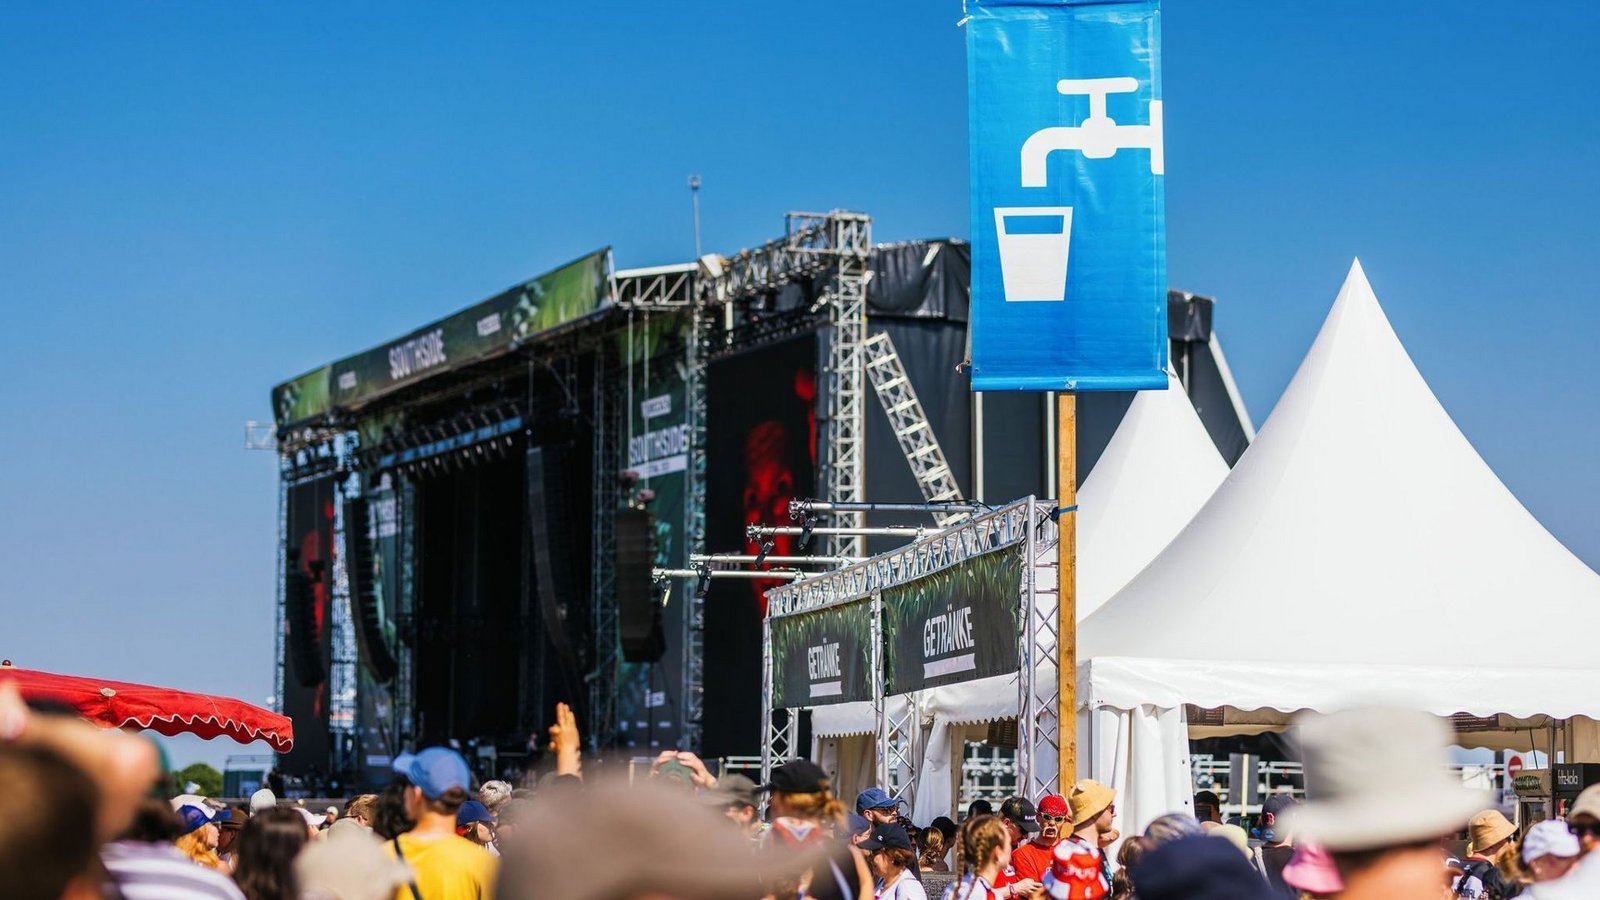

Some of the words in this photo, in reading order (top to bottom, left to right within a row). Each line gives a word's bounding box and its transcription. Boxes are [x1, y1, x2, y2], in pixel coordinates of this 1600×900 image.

[389, 328, 446, 380] SOUTHSIDE
[630, 423, 689, 464] SOUTHSIDE
[923, 603, 975, 658] GETRÄNKE
[807, 637, 841, 680] GETRÄNKE
